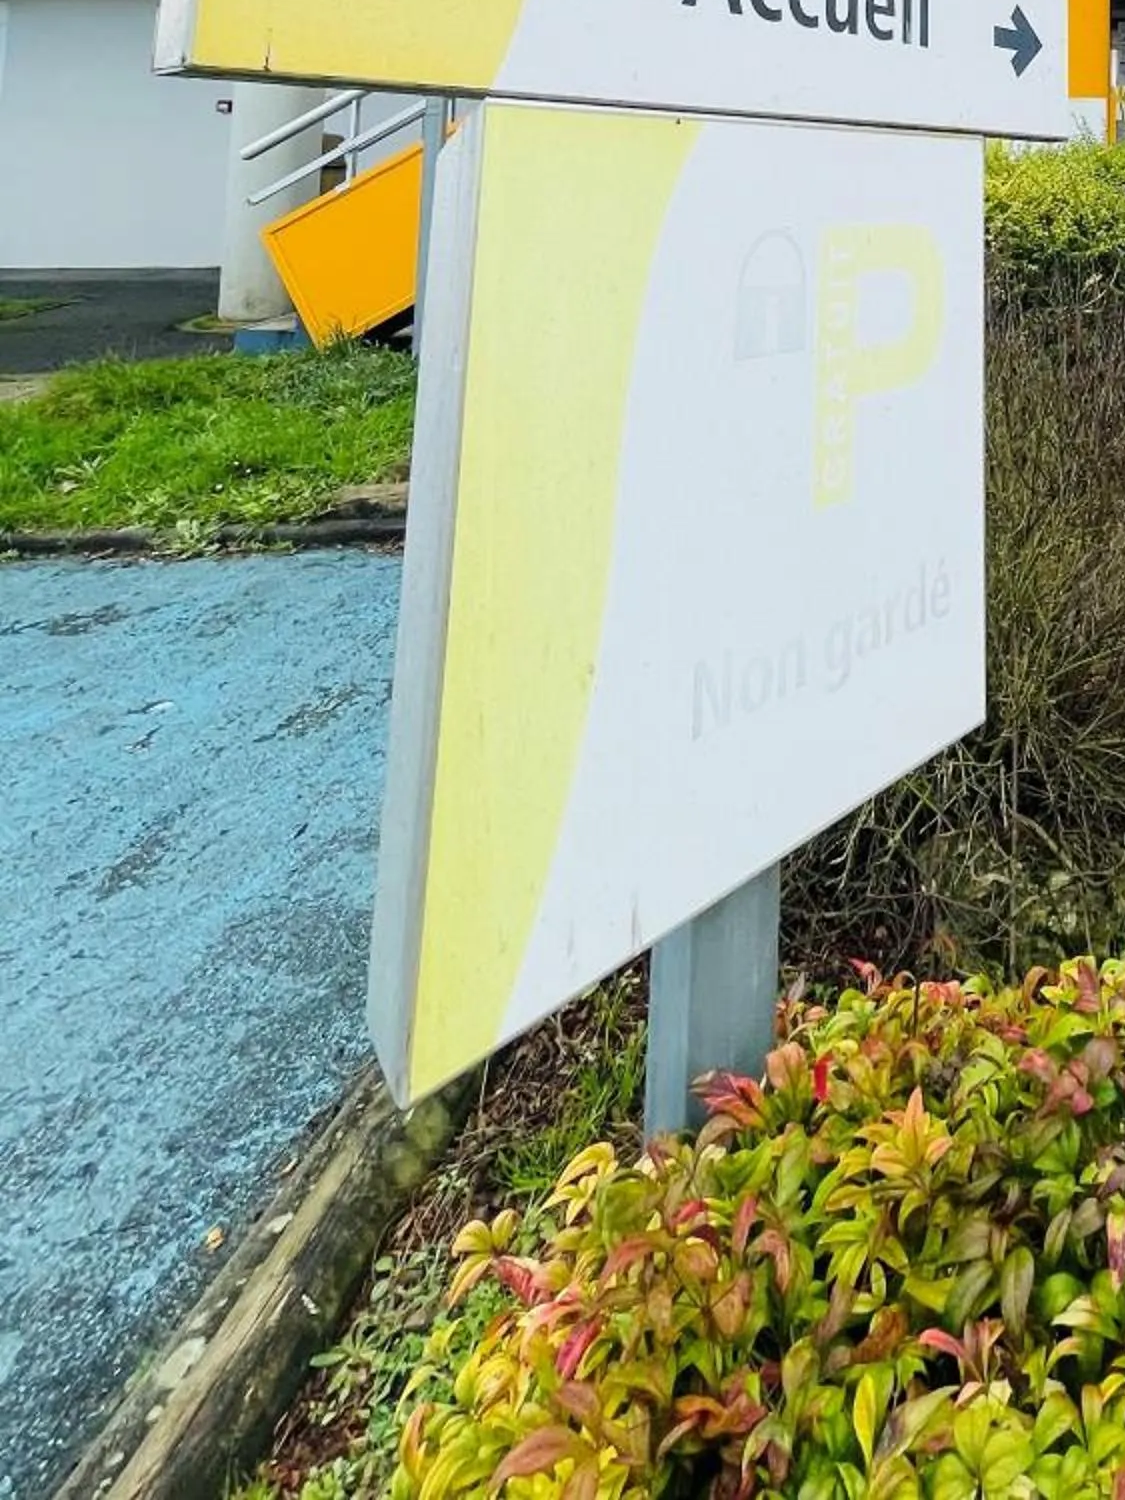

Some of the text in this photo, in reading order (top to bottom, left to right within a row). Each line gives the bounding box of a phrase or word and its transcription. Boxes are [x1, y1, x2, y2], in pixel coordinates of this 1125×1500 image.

[814, 222, 947, 515] P
[690, 556, 953, 742] Non gardé
